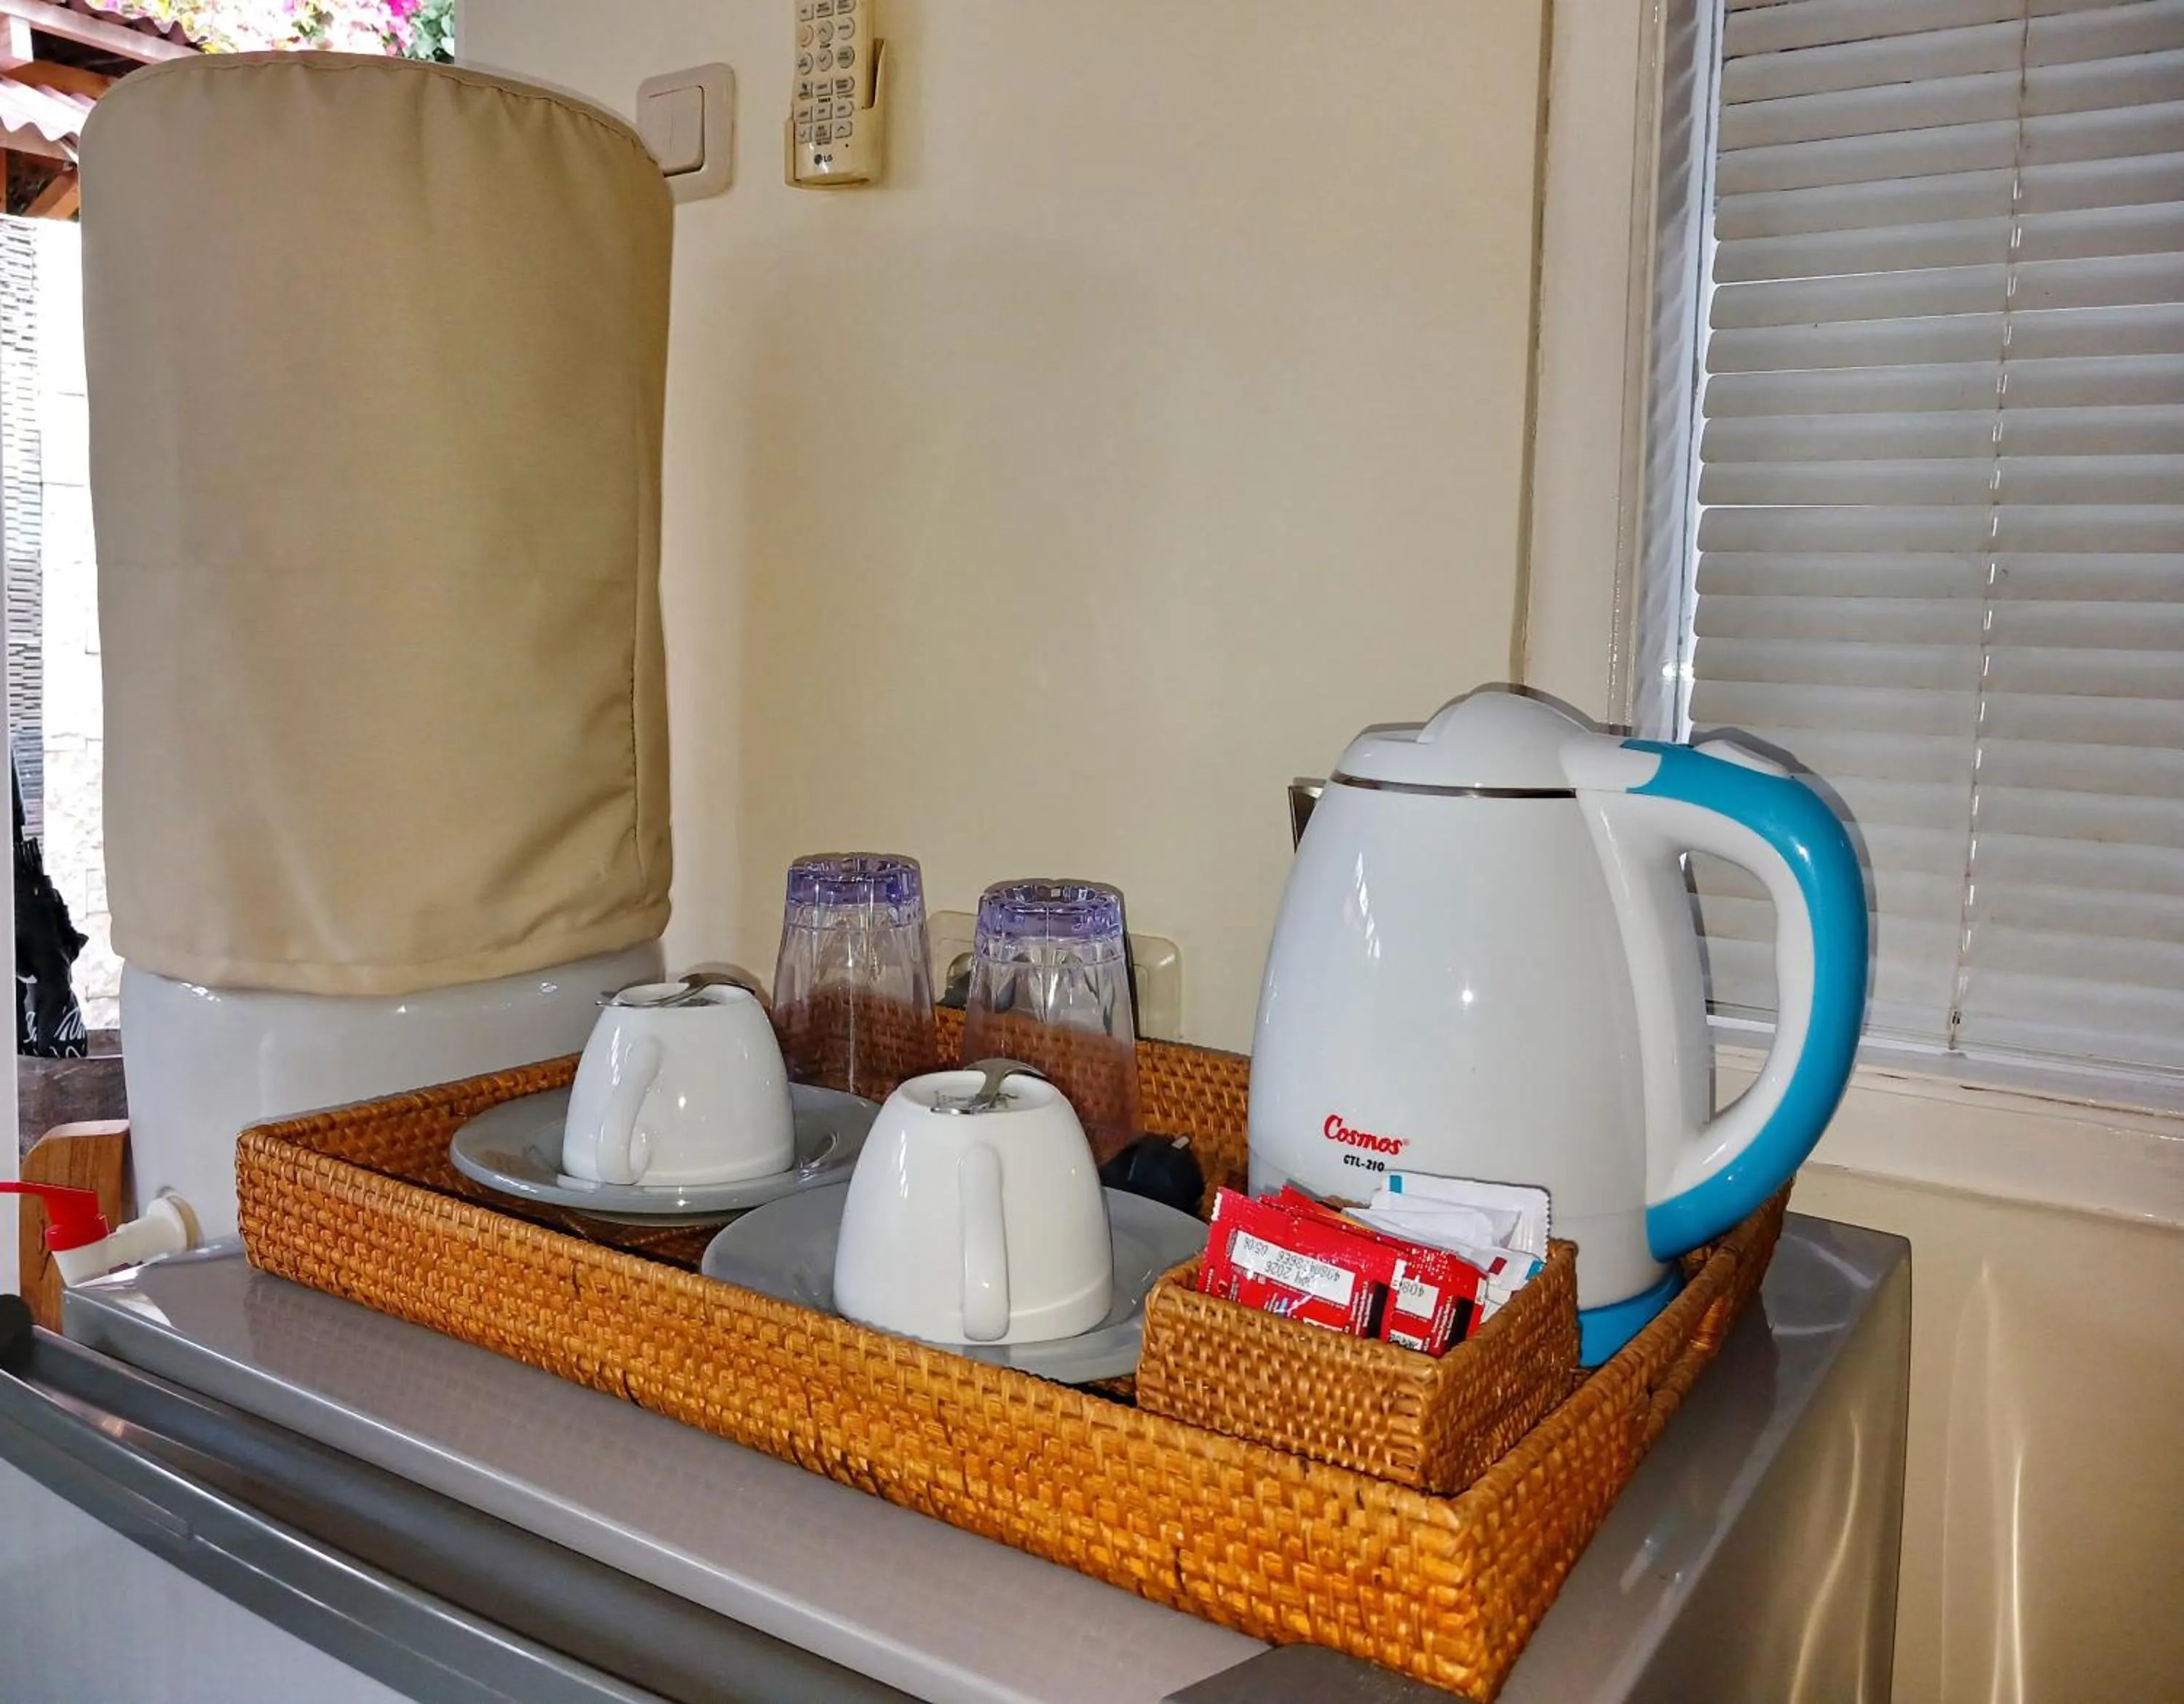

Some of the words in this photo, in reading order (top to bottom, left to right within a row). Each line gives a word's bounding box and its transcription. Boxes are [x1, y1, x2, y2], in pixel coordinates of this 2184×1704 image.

[823, 154, 833, 162] LG
[1324, 1113, 1403, 1156] Cosmos
[1342, 1153, 1385, 1172] CTL-210
